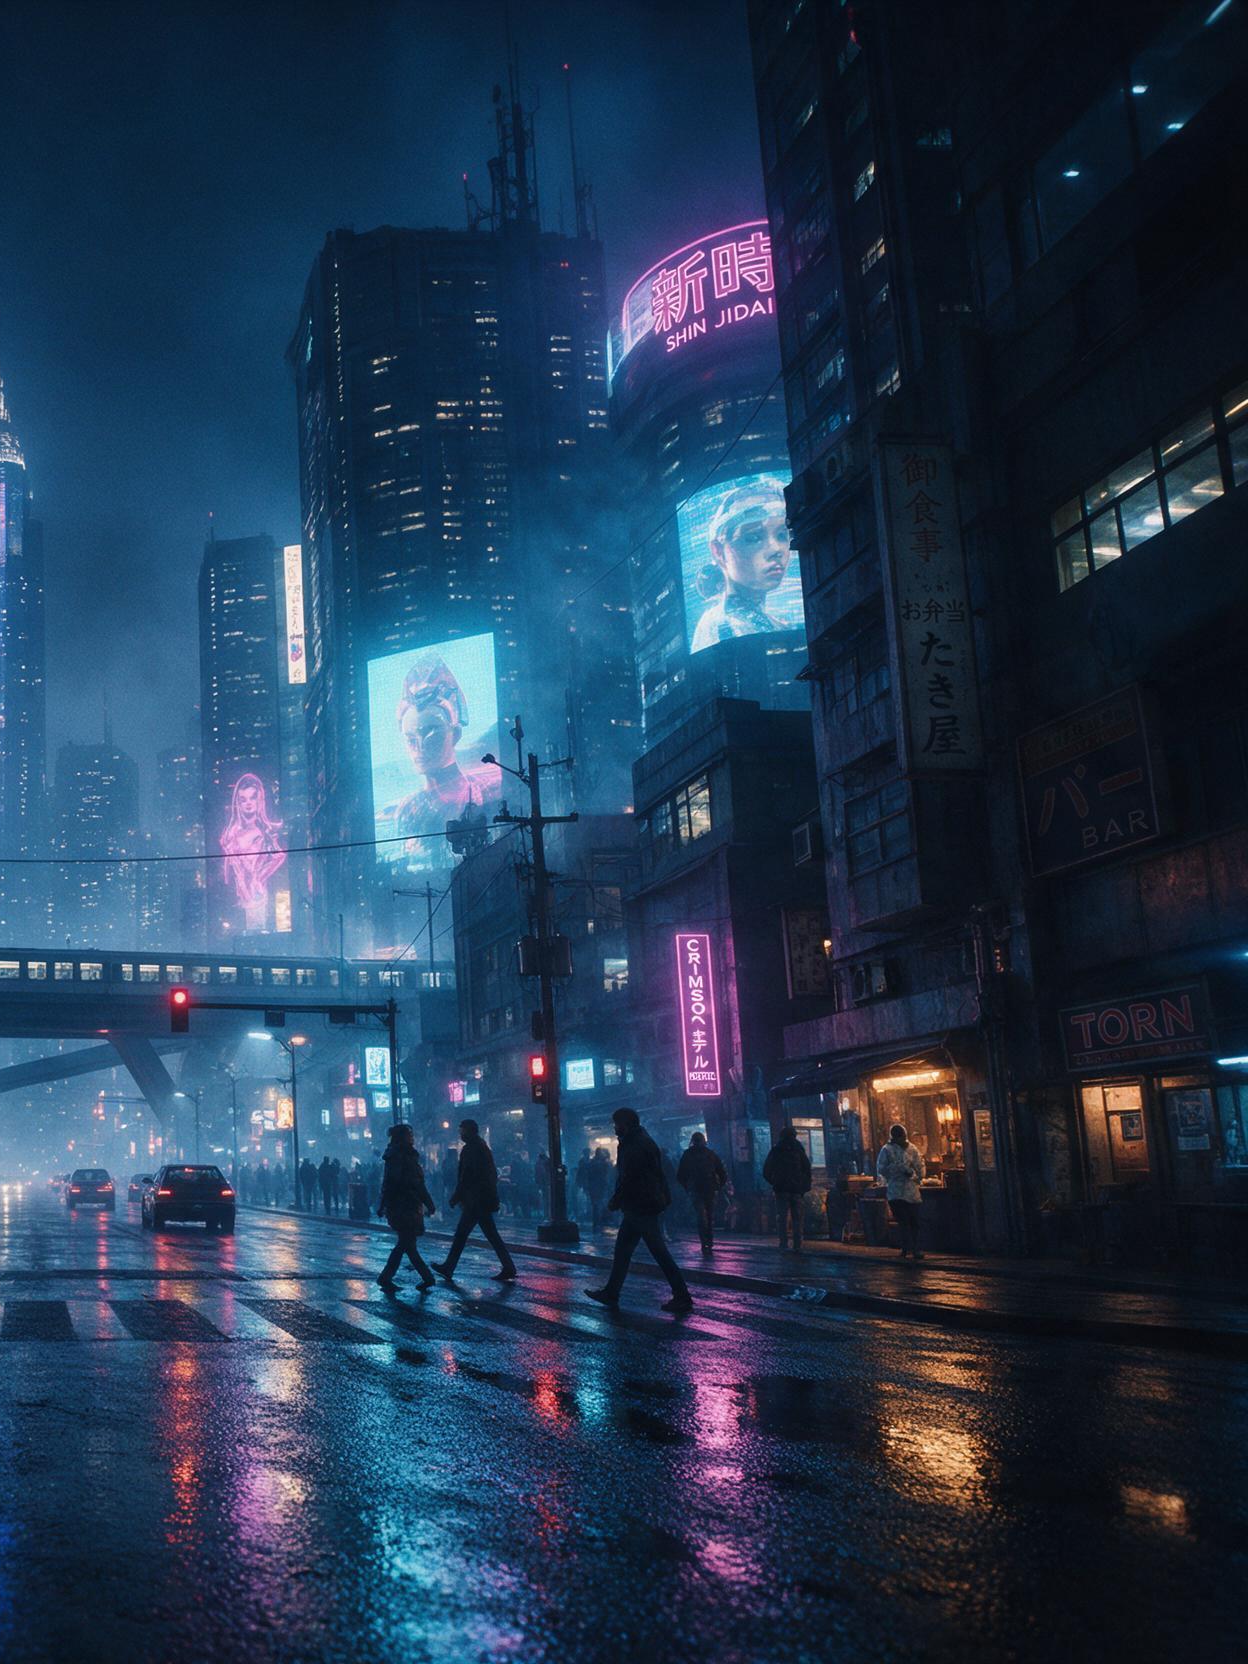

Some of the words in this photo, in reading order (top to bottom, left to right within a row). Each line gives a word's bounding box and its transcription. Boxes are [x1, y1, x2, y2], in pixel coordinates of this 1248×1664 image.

[667, 318, 707, 352] SHIN
[714, 297, 773, 329] JIDAI
[900, 455, 943, 563] 御食事
[920, 631, 967, 755] たき屋
[1081, 809, 1150, 849] BAR
[1070, 994, 1195, 1049] TORN
